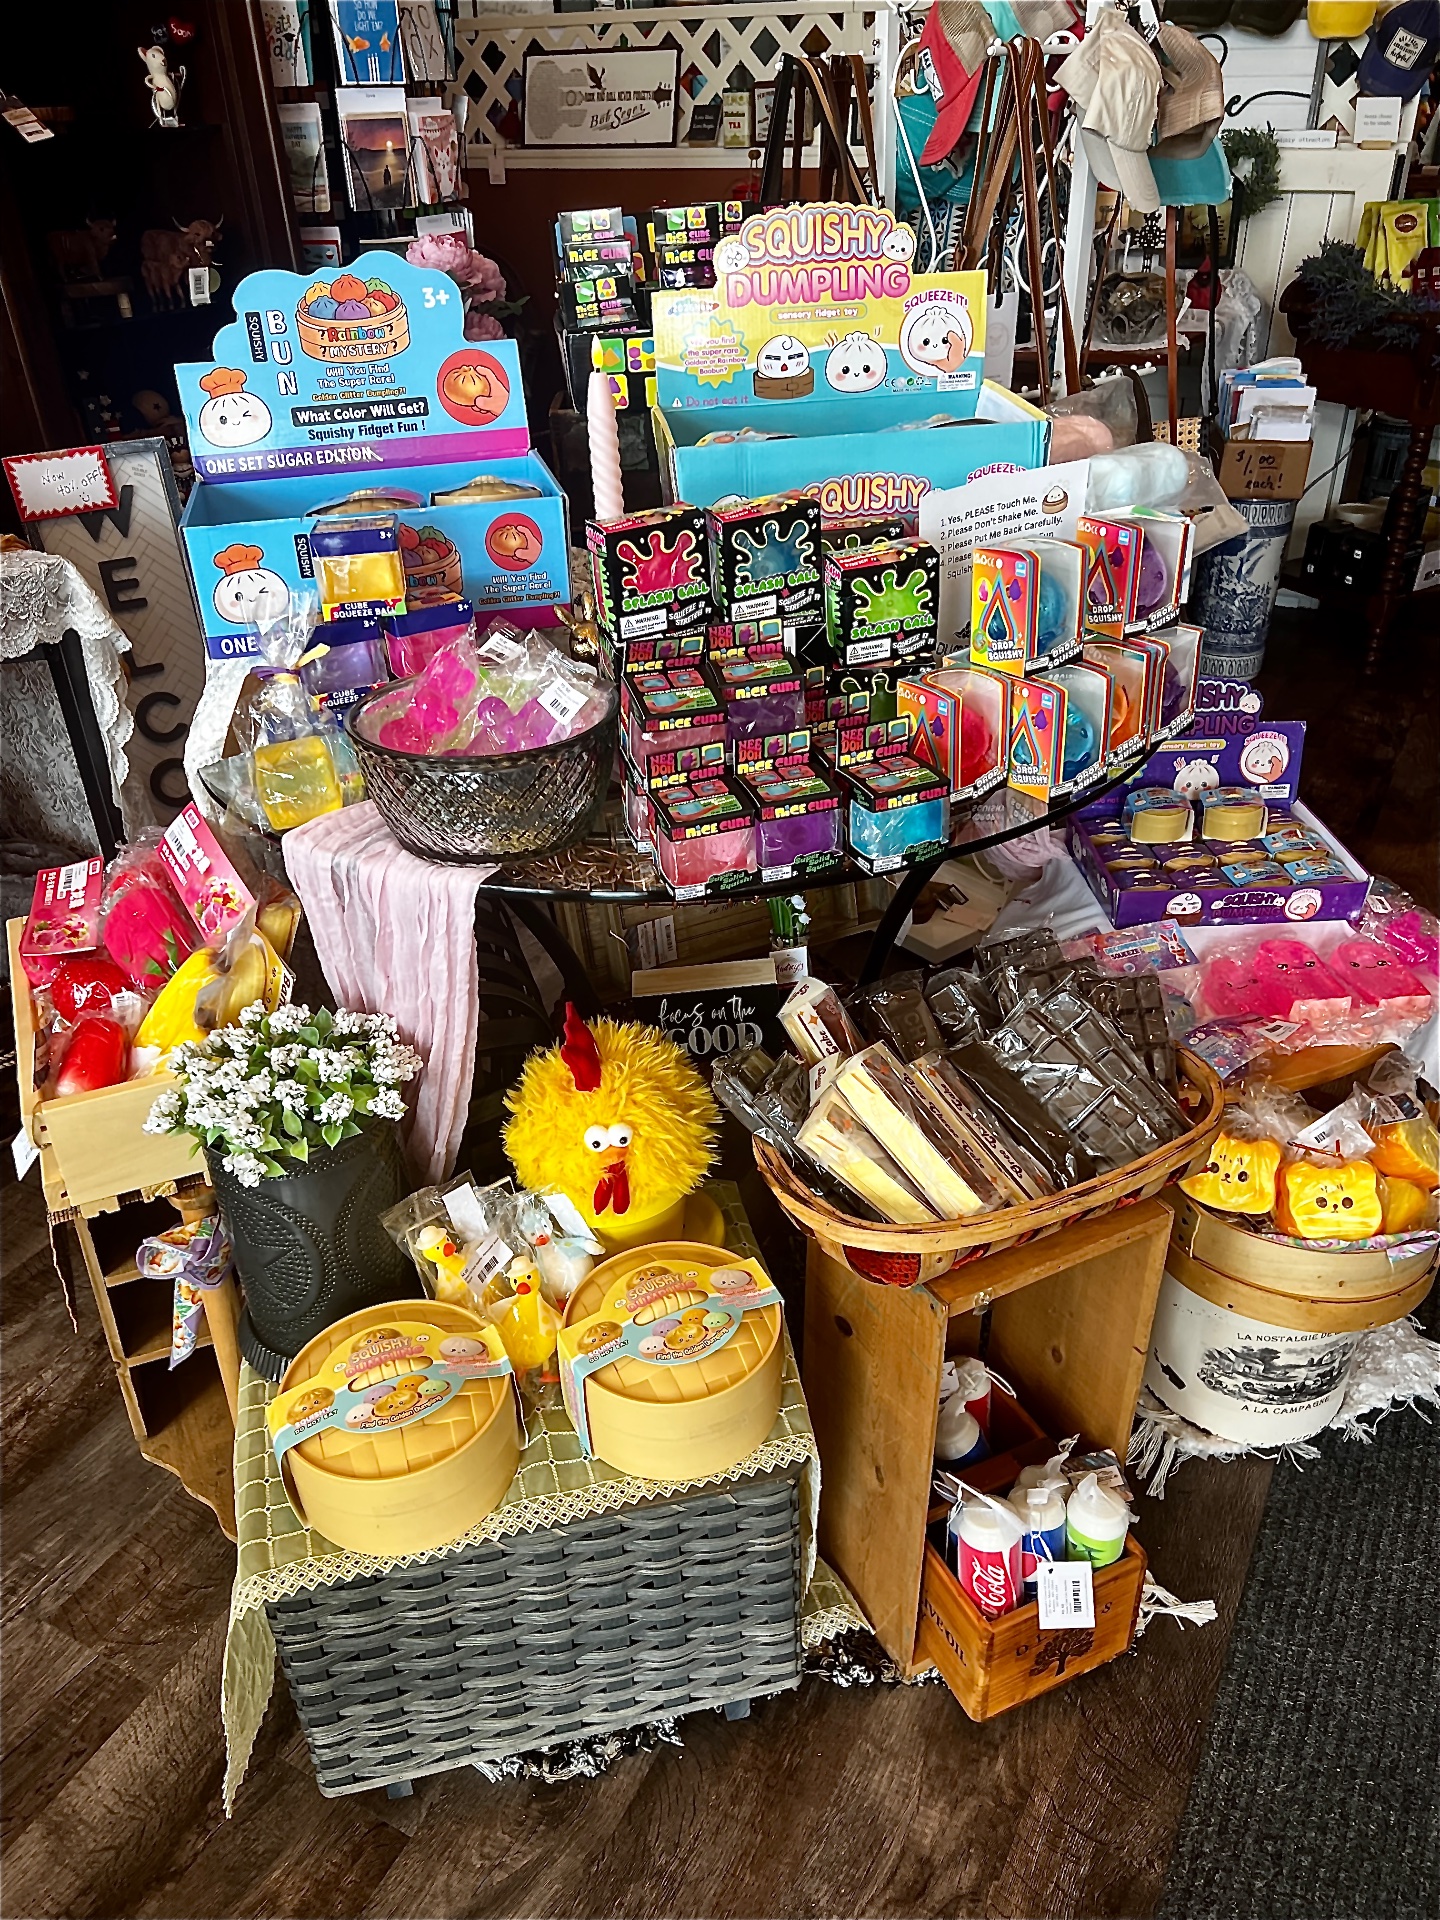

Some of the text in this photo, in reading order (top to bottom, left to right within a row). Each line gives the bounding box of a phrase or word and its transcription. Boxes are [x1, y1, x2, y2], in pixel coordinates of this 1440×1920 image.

[747, 209, 889, 259] SQUISHY
[727, 263, 911, 308] DUMPLING
[422, 287, 450, 309] 3+
[903, 292, 969, 314] SQUEEZE-IT!
[777, 306, 859, 321] sensory fidget toy
[248, 316, 265, 361] SQUISHY
[327, 327, 385, 343] Rainbow
[329, 344, 390, 358] MYSTERY
[701, 350, 722, 358] super
[347, 366, 366, 375] You
[369, 364, 390, 374] Find
[317, 379, 335, 389] The
[338, 377, 366, 387] Super
[686, 395, 749, 407] Do not eat it
[296, 401, 425, 424] What Color Will Get?
[308, 421, 417, 441] Squishy Fidget Fun
[206, 447, 374, 474] ONE SET SUGAR EDITION
[804, 475, 927, 514] SQUISHY
[948, 515, 963, 525] Yes,
[965, 504, 995, 520] PLEASE
[997, 498, 1021, 511] Touch
[1022, 496, 1038, 505] Me.
[940, 508, 1039, 540] 2. Please Don't Shake Me.
[380, 531, 392, 540] 3+
[940, 516, 1063, 554] 3. Please Put Me Back Carefully.
[297, 537, 312, 577] SQUISHY
[947, 552, 972, 566] Please
[734, 569, 820, 598] SPLASH BALL
[345, 602, 368, 610] CUBE
[622, 581, 710, 612] SPLASH BALL
[333, 608, 373, 619] SQUEEZE
[1088, 613, 1122, 623] SQUISHY
[1093, 605, 1114, 613] DROP
[851, 614, 935, 640] SPLASH BALL
[221, 636, 258, 656] ONE
[988, 649, 1024, 661] SQUISHY
[992, 641, 1014, 651] DROP
[1199, 684, 1245, 709] ISHY
[1012, 773, 1048, 784] SQUISHY
[1016, 766, 1038, 775] DROP
[1212, 907, 1281, 918] DUMPLING
[658, 994, 756, 1030] focus on the
[665, 1022, 763, 1055] GOOD
[629, 1272, 683, 1301] SQUISHY
[1237, 1332, 1252, 1341] LA
[1256, 1333, 1319, 1343] NOSTALGIE
[352, 1336, 413, 1365] SQUISHY
[1241, 1404, 1250, 1412] A
[1273, 1395, 1330, 1415] CAMPAGNE
